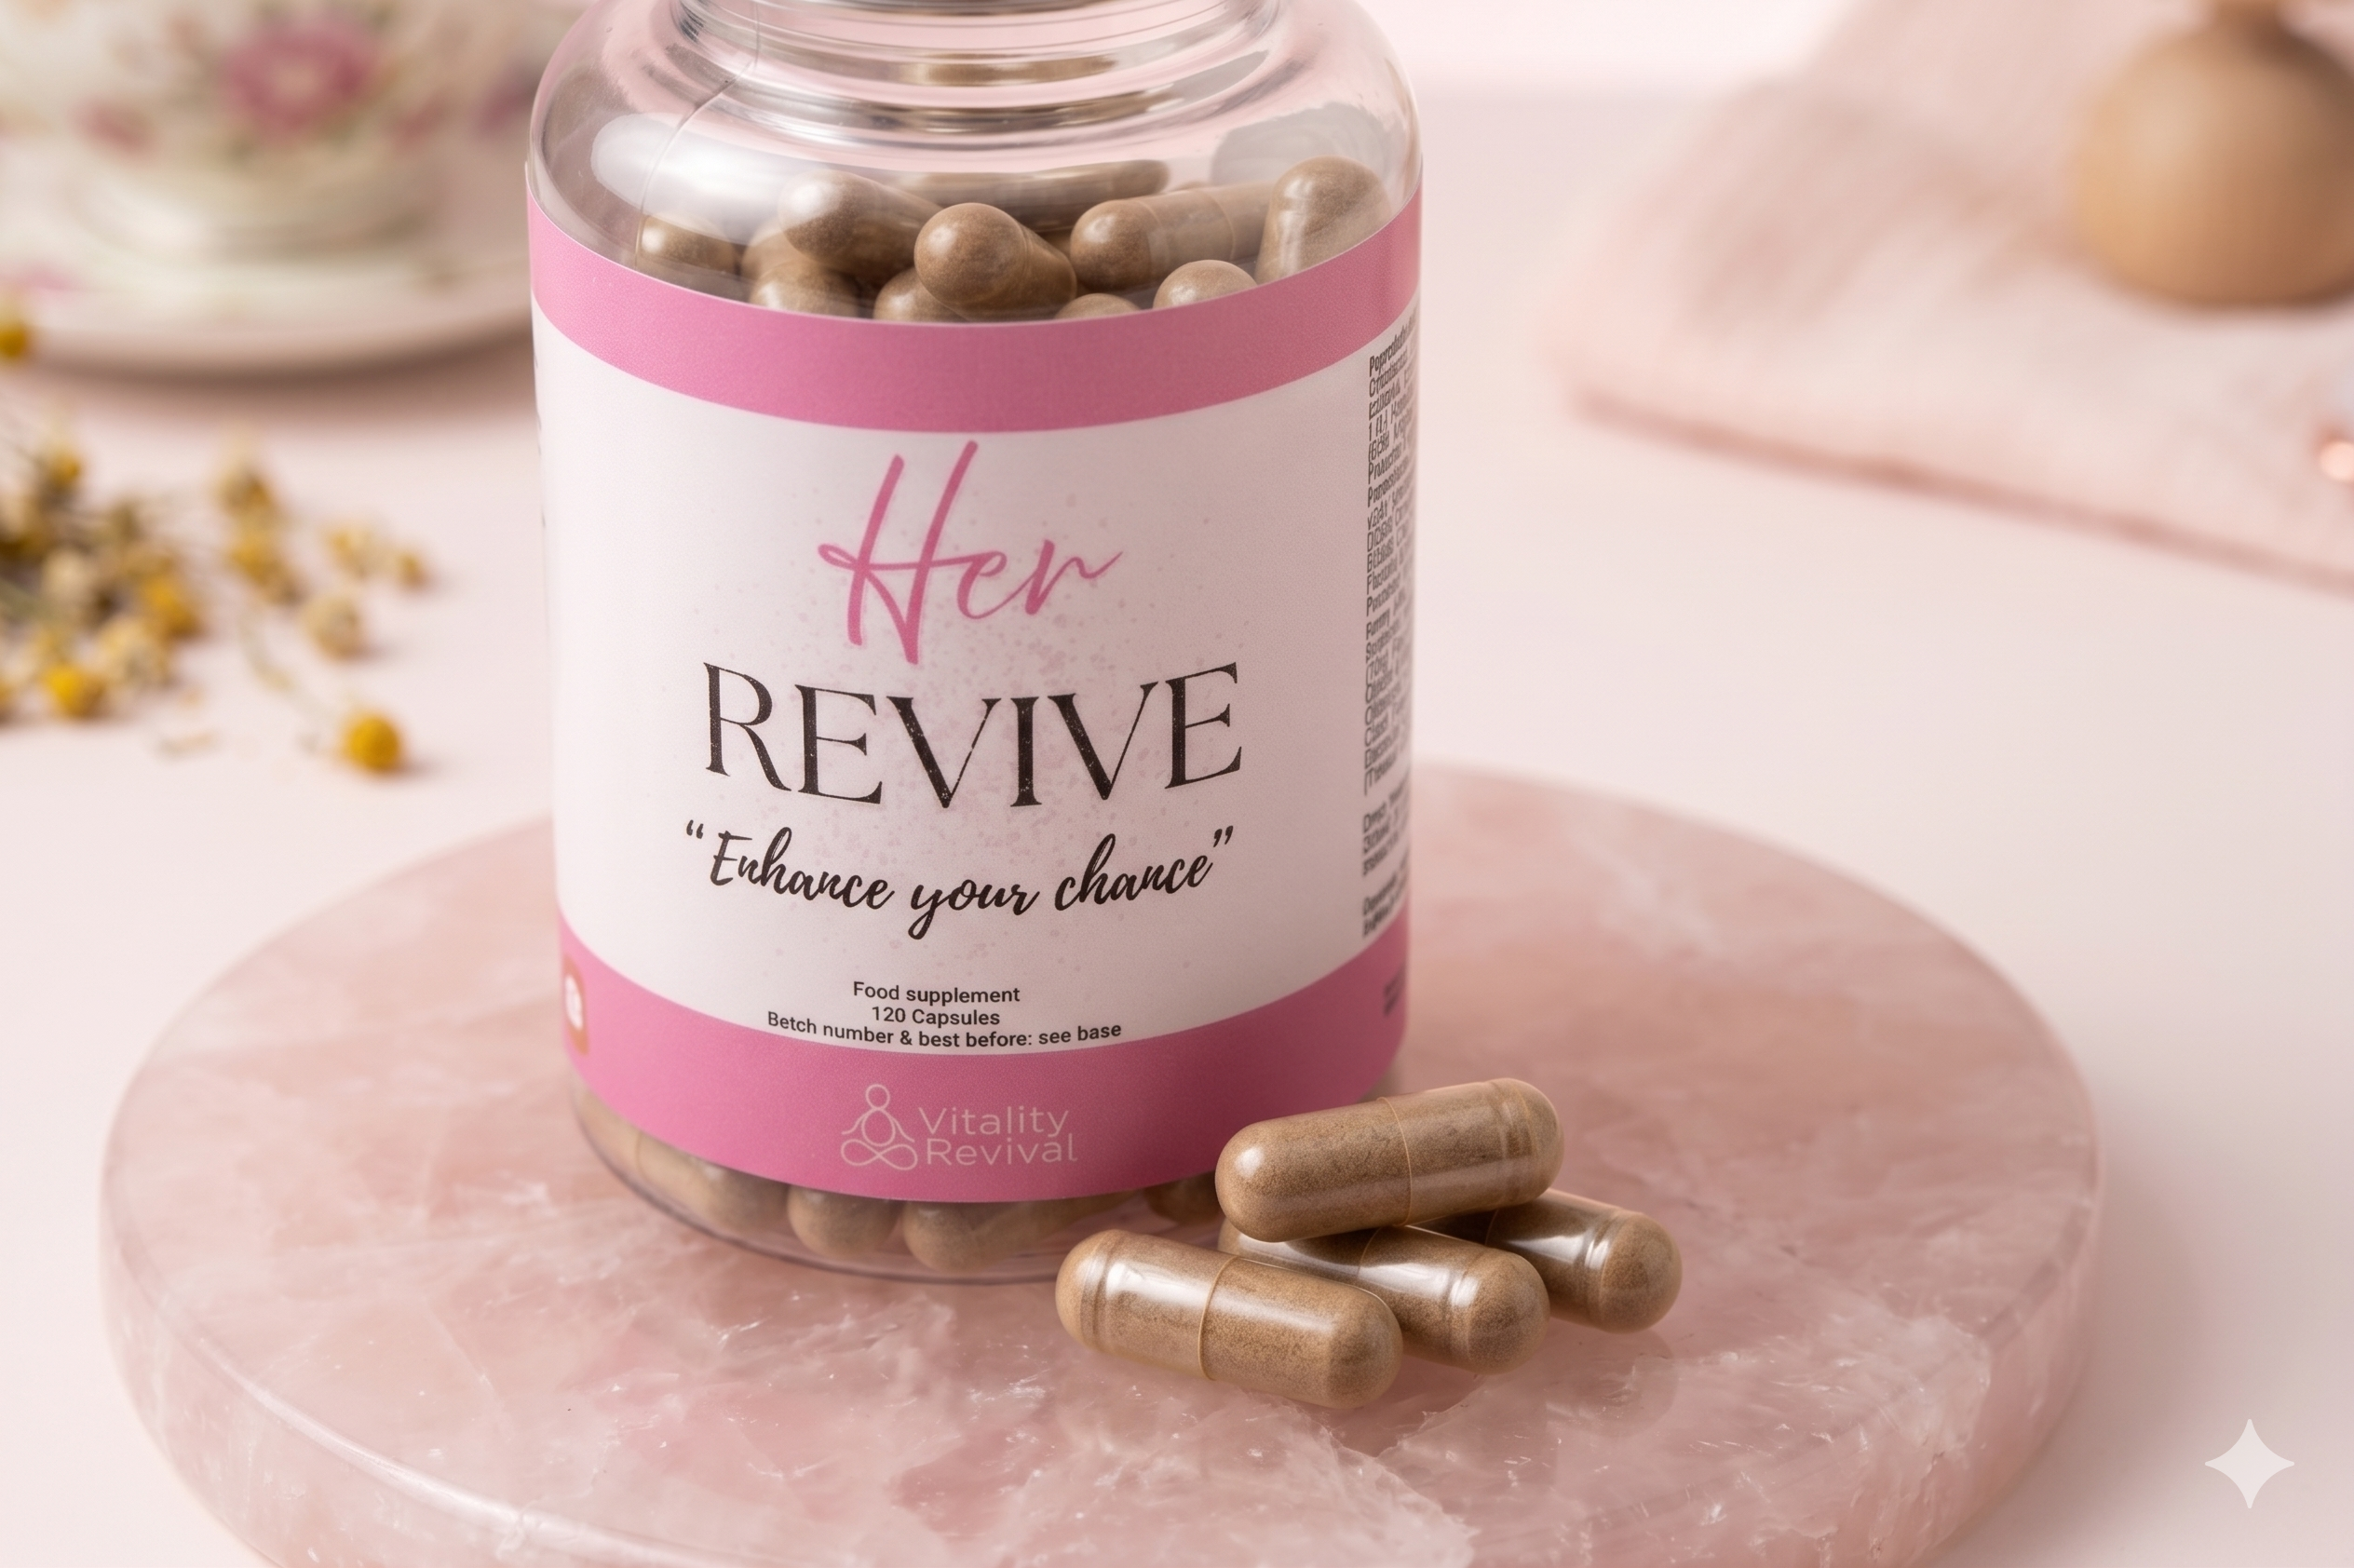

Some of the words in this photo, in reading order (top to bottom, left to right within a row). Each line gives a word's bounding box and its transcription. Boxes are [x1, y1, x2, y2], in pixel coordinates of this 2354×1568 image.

[818, 440, 1123, 665] Her
[703, 662, 1242, 808] REVIVE
[908, 880, 1040, 940] your
[854, 981, 900, 1001] Food
[906, 986, 1021, 1007] supplement
[767, 1011, 818, 1034] Betch
[823, 1023, 894, 1044] number
[900, 1030, 913, 1046] &
[919, 1030, 960, 1048] best
[967, 1031, 1033, 1048] before:
[1038, 1030, 1072, 1045] see
[1077, 1023, 1122, 1042] base
[872, 1007, 906, 1022] 120
[912, 1007, 1001, 1028] Capsules
[918, 1105, 1069, 1138] Vitality
[927, 1133, 1077, 1166] Revival
